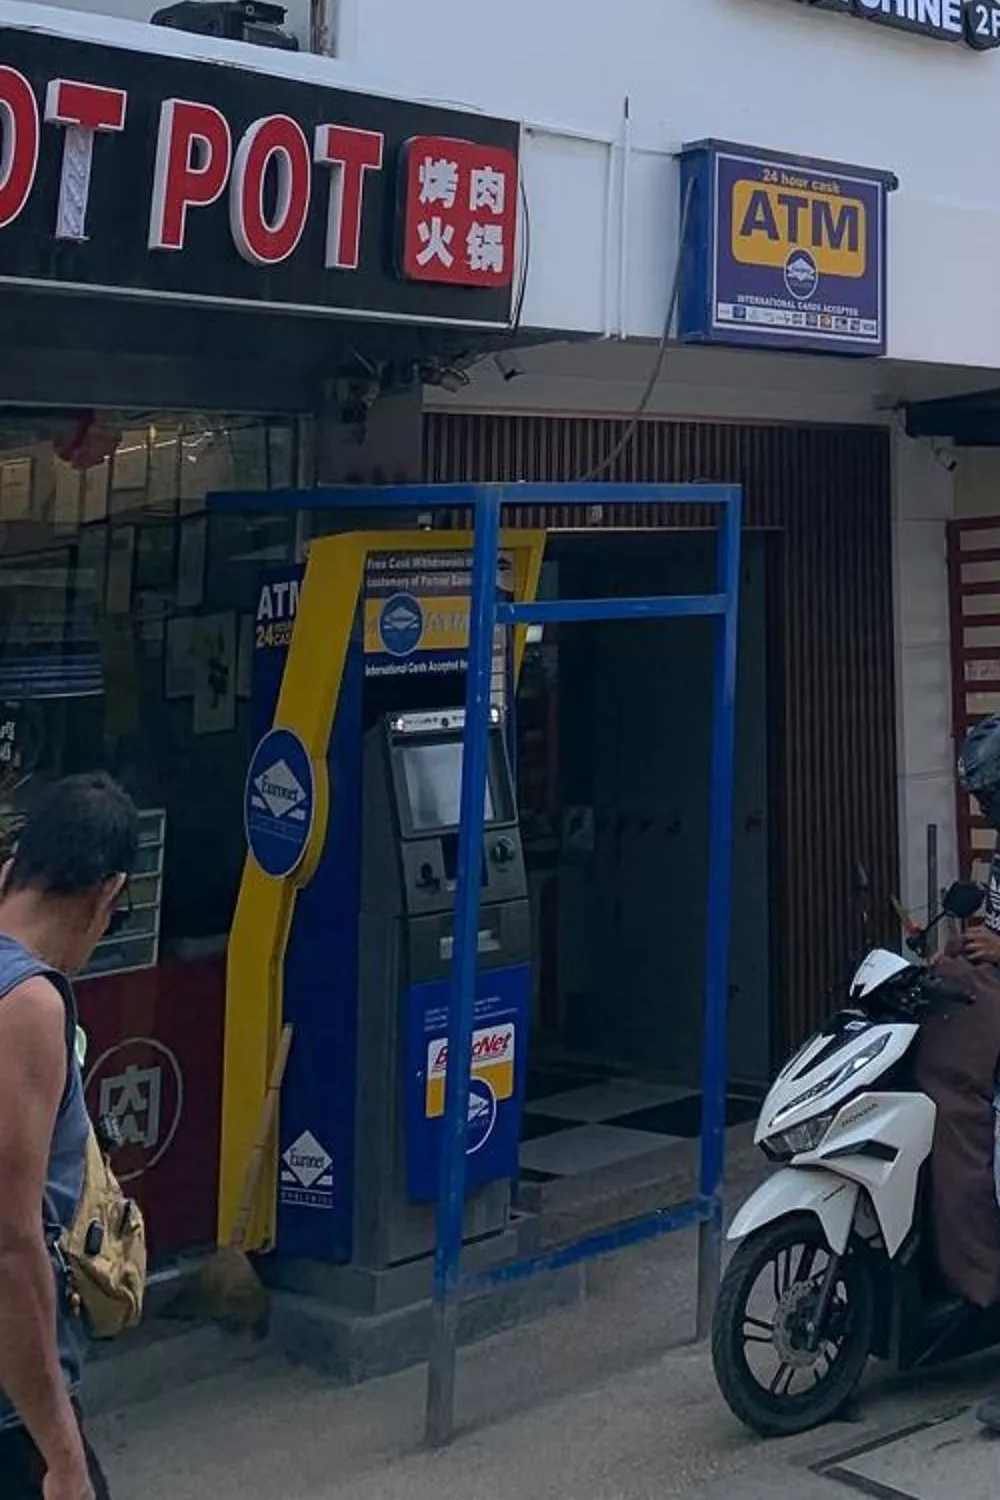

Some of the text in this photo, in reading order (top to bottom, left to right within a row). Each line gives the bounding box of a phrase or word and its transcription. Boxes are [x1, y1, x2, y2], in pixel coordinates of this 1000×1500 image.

[148, 97, 385, 269] POT
[418, 155, 506, 215] 烤肉
[762, 168, 779, 183] 24
[780, 171, 808, 189] hour
[415, 215, 505, 274] 火锅
[739, 189, 859, 252] ATM
[99, 1064, 161, 1148] 肉
